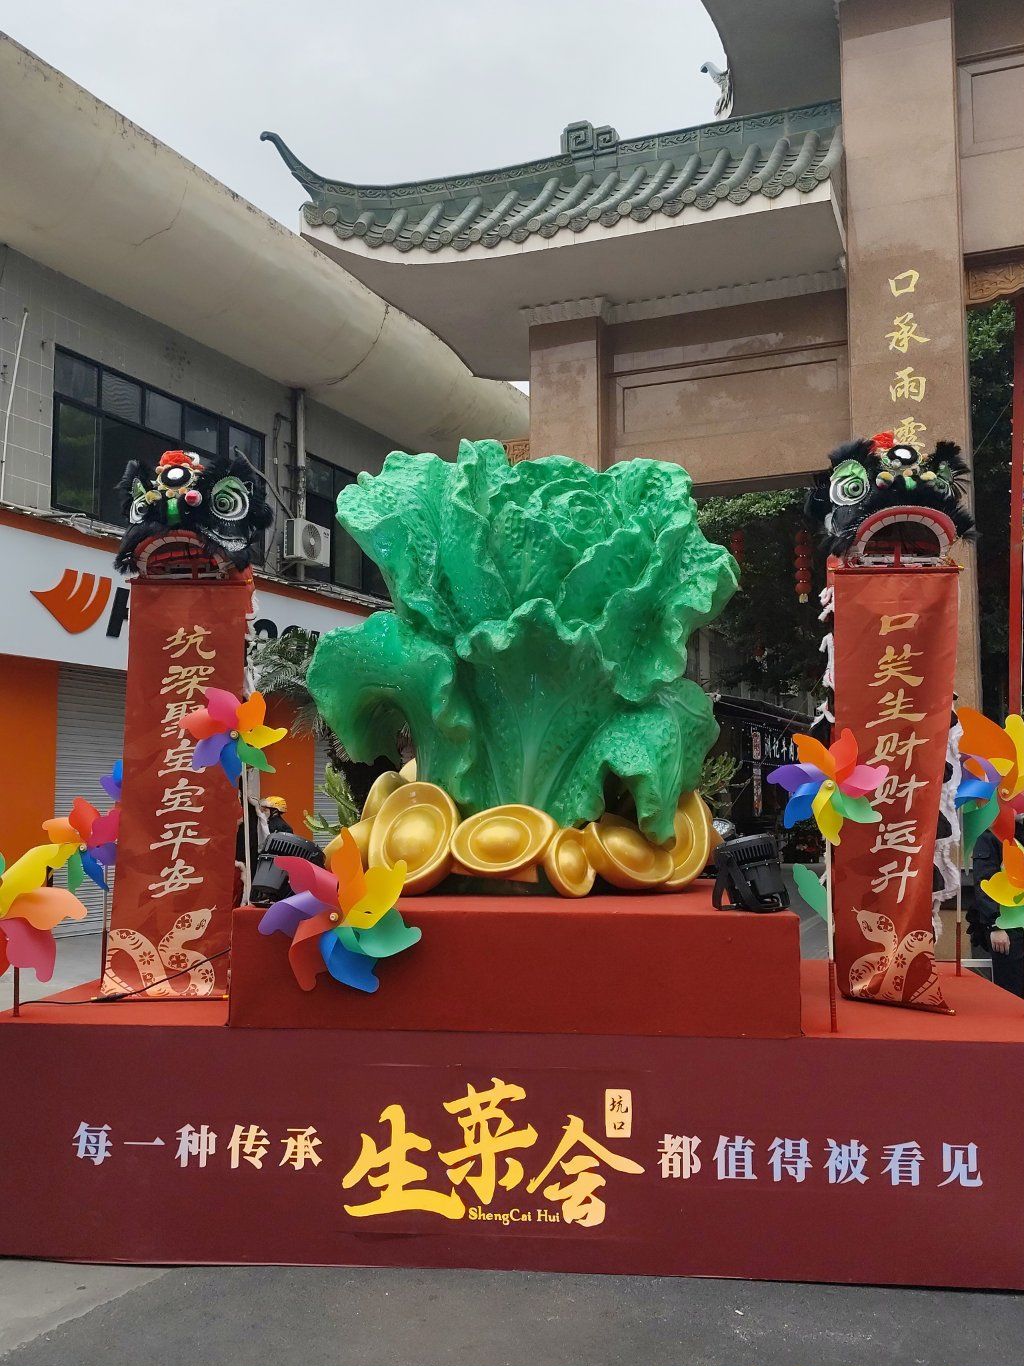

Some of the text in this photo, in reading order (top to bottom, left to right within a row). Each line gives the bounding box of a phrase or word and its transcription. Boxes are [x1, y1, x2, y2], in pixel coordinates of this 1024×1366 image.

[609, 1094, 629, 1132] 坑口
[72, 1121, 323, 1171] 每一种传承
[342, 1077, 645, 1228] 生菜会
[657, 1133, 983, 1188] 都值得被看见
[468, 1206, 561, 1225] ShengCai Hui
